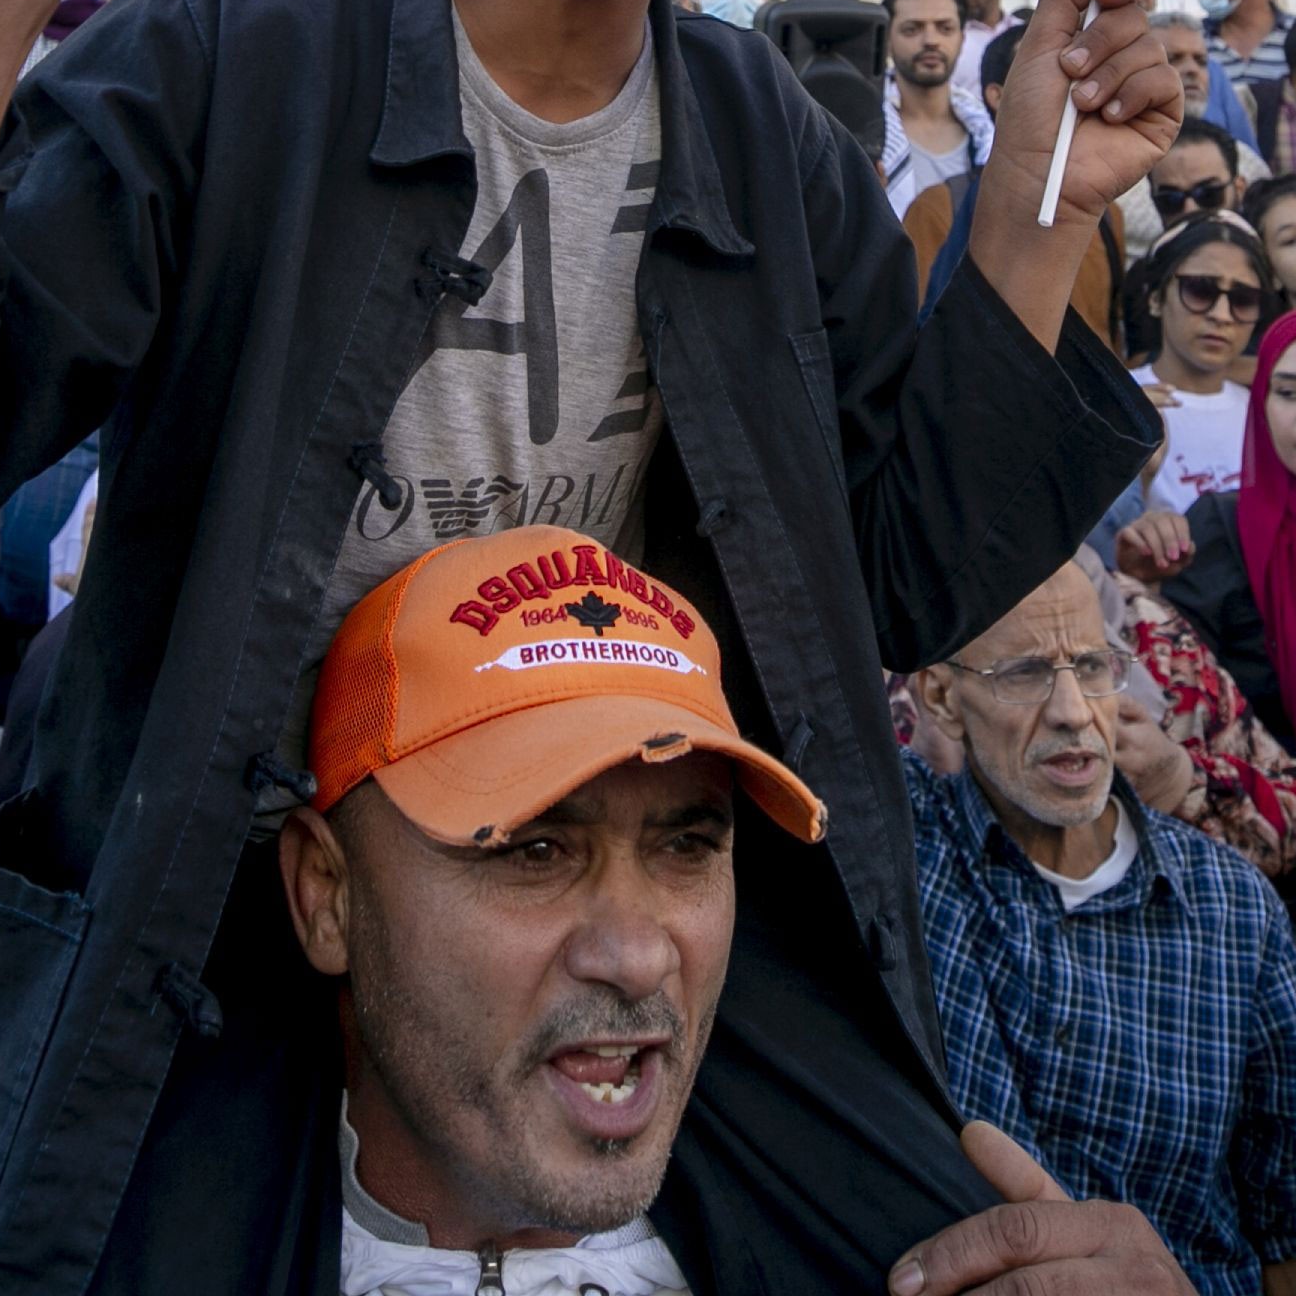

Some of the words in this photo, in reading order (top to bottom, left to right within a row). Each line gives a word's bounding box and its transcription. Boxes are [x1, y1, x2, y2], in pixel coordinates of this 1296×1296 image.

[450, 544, 696, 639] DSQUARED2
[519, 606, 568, 628] 1964
[519, 640, 680, 668] BROTHERHOOD
